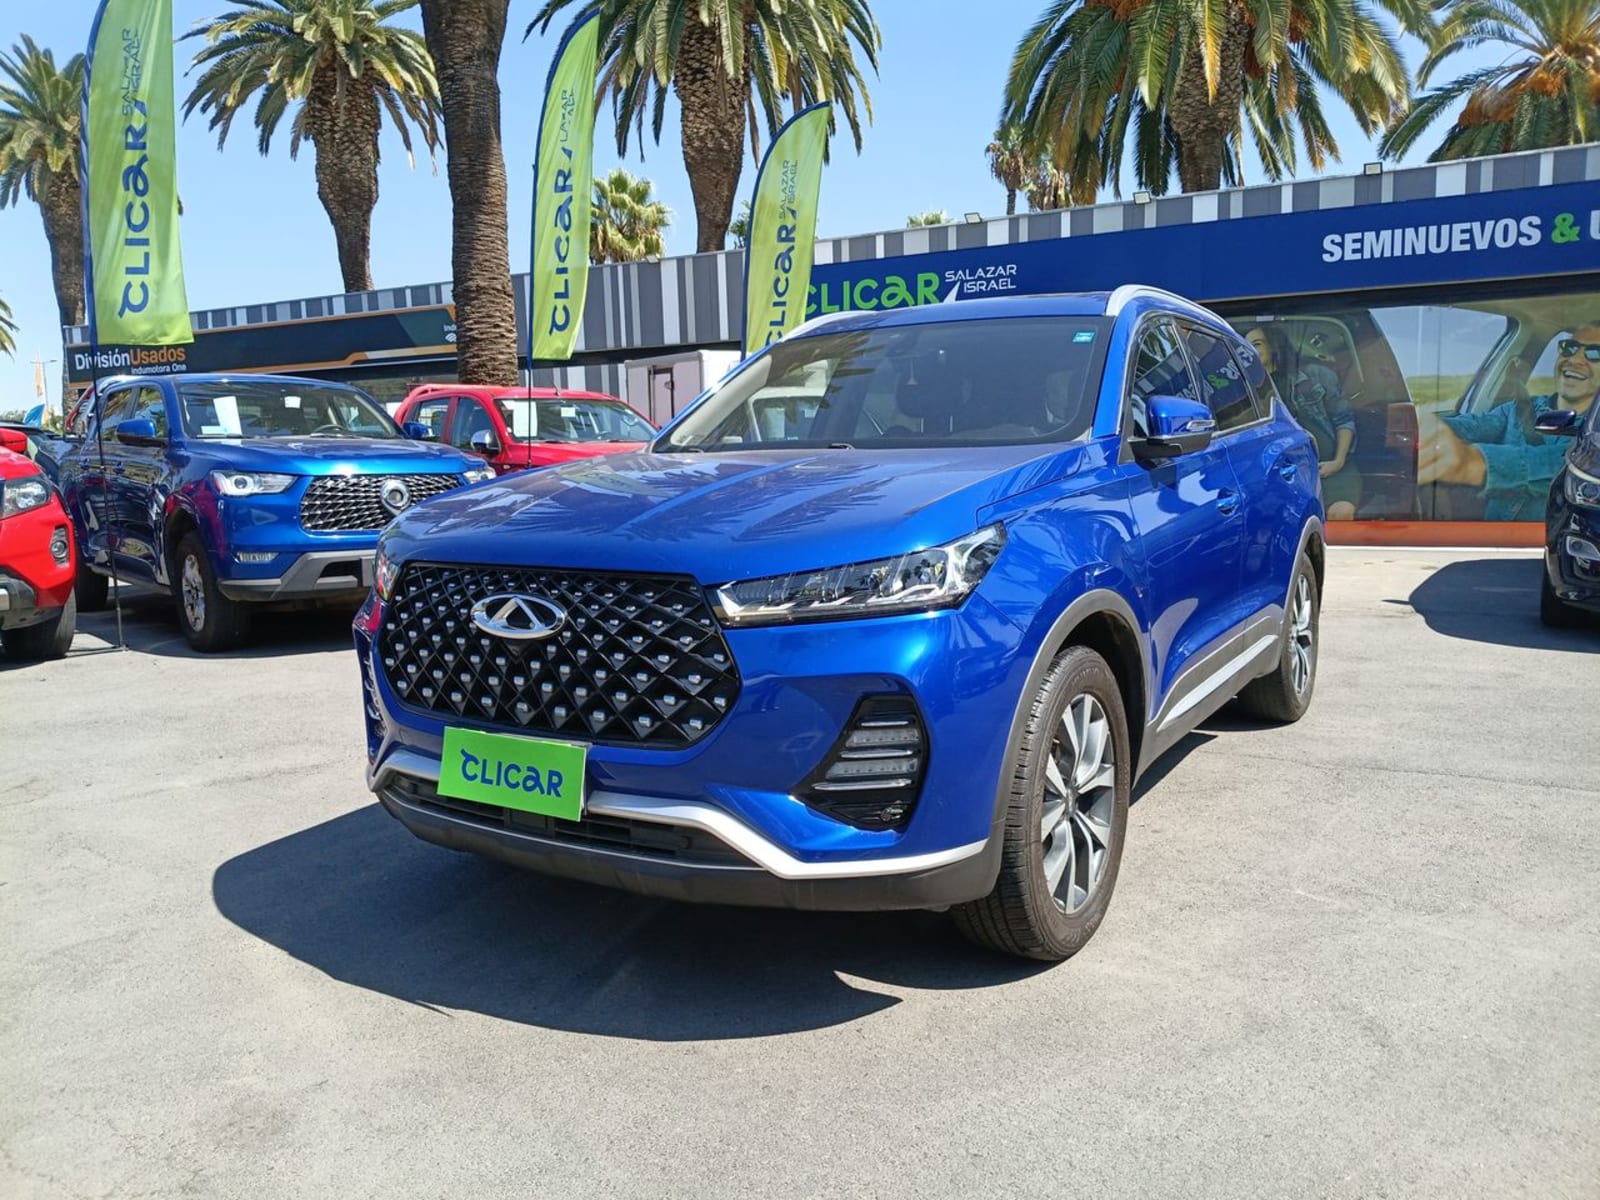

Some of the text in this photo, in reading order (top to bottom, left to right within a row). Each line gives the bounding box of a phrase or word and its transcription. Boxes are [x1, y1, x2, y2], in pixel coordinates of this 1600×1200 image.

[1322, 215, 1542, 263] SEMINUEVOS
[1551, 213, 1581, 244] &
[944, 264, 1017, 283] SALAZAR
[963, 277, 1017, 294] ISRAEL
[171, 362, 187, 372] One
